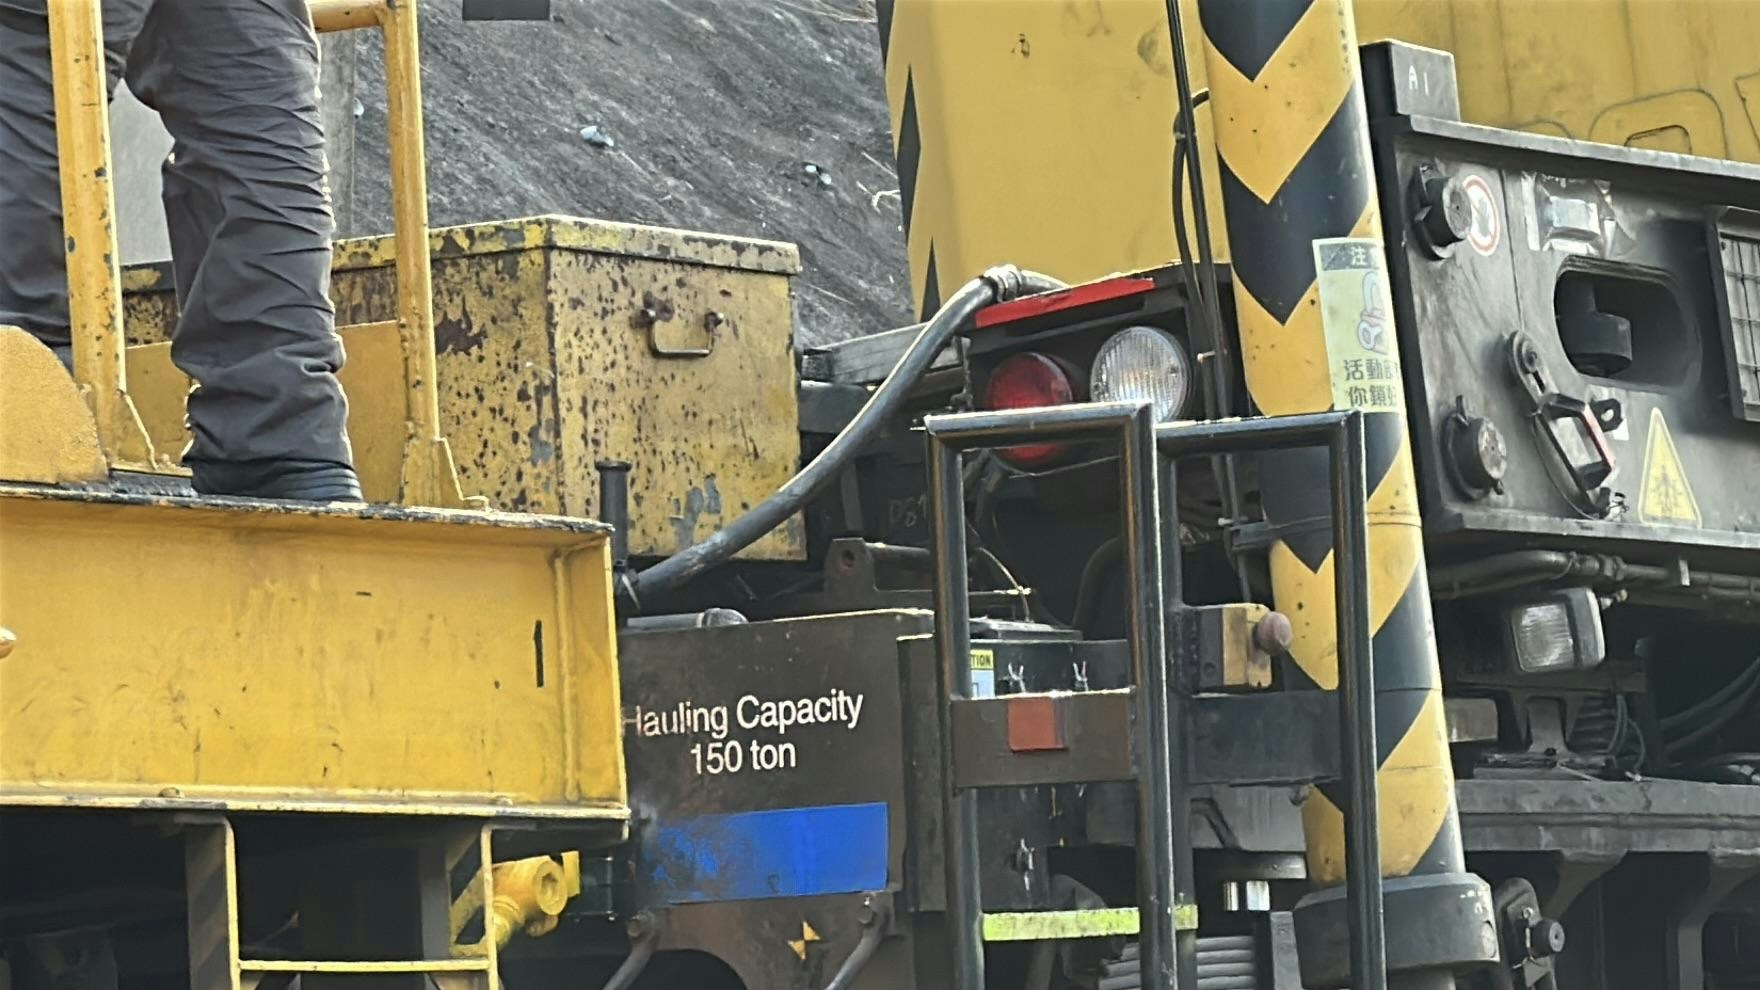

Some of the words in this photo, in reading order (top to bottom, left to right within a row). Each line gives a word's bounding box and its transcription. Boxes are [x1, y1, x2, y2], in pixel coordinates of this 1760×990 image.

[621, 700, 729, 740] Hauling
[736, 688, 864, 734] Capacity
[691, 740, 743, 775] 150
[749, 739, 796, 770] ton
